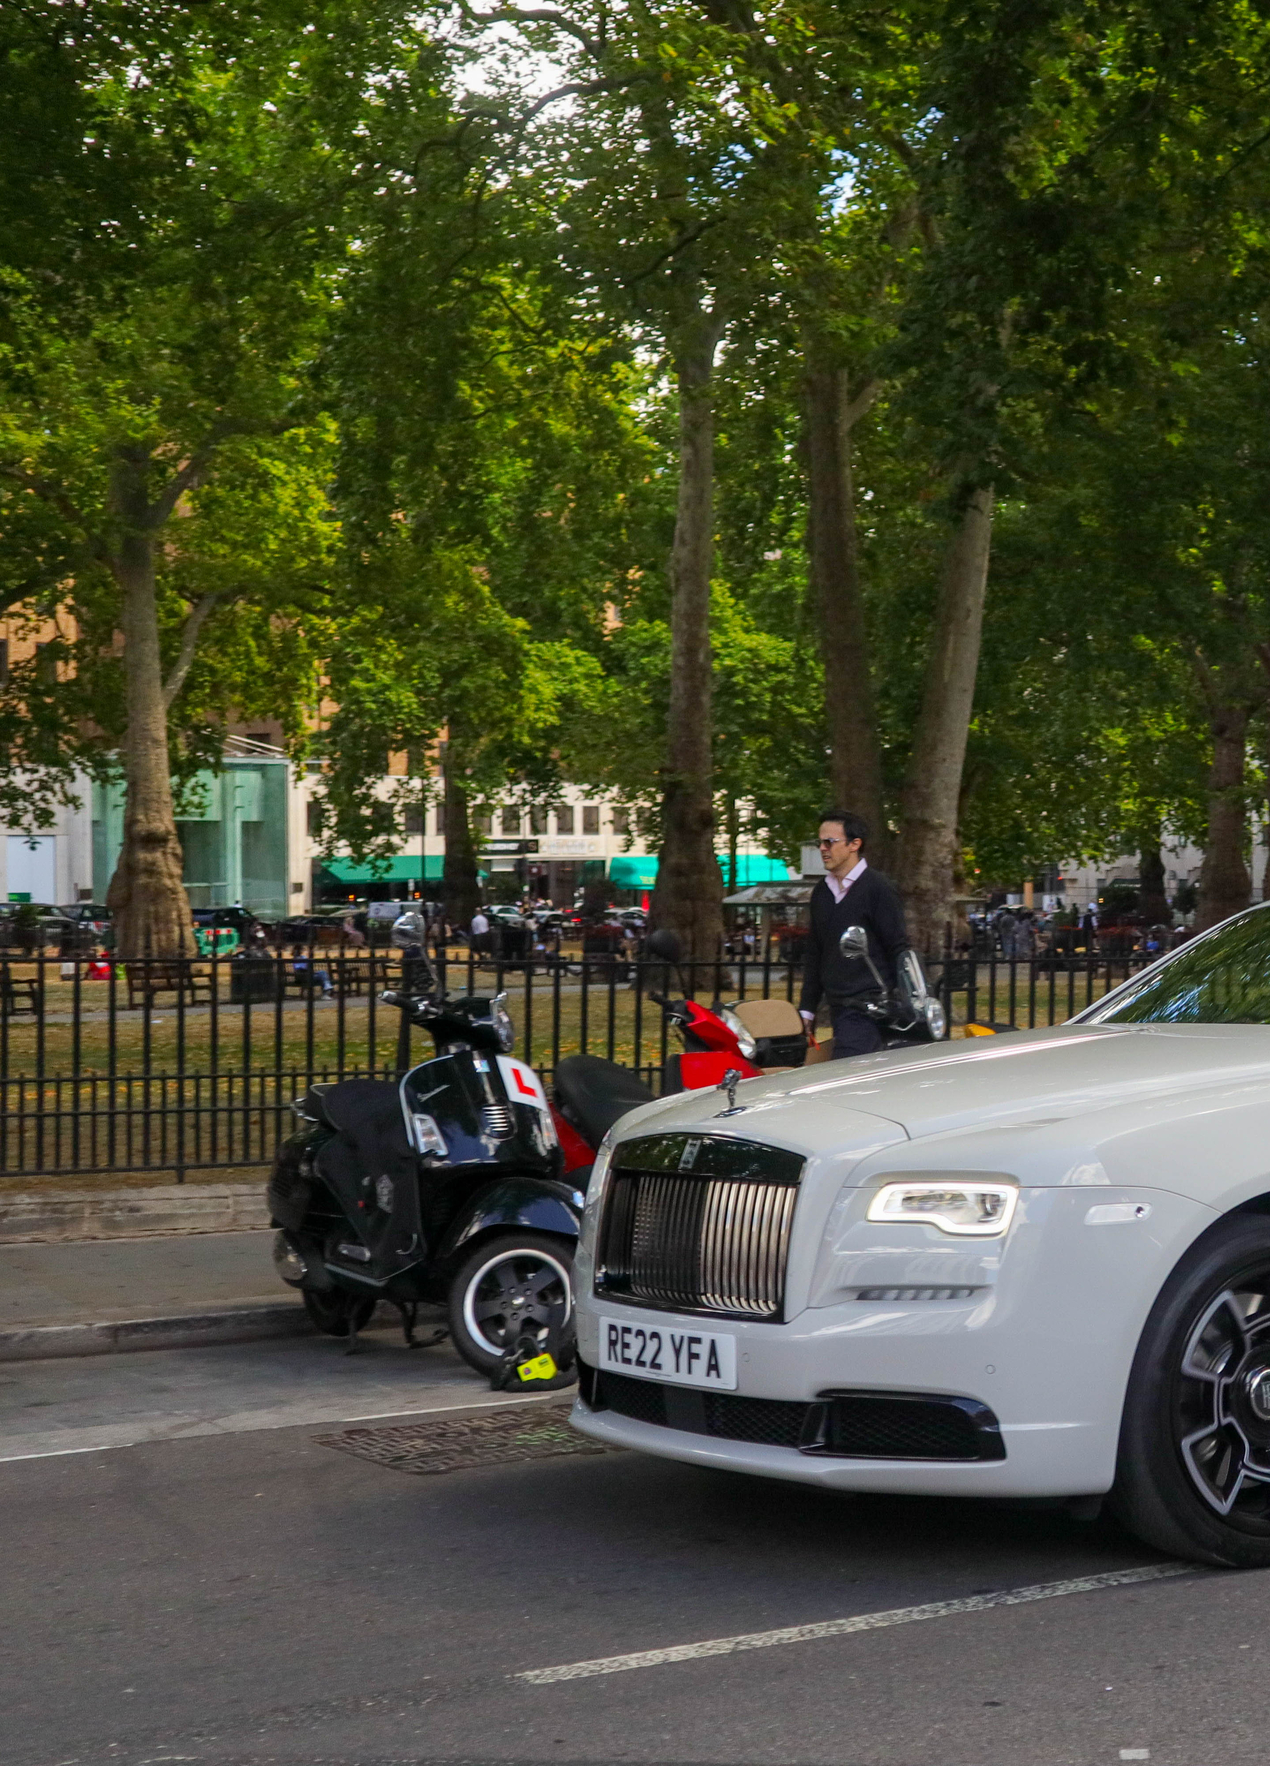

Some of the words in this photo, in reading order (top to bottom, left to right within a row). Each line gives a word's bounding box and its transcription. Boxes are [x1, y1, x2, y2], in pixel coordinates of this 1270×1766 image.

[511, 1068, 538, 1098] L
[607, 1324, 662, 1370] RE22
[671, 1334, 721, 1378] YFA
